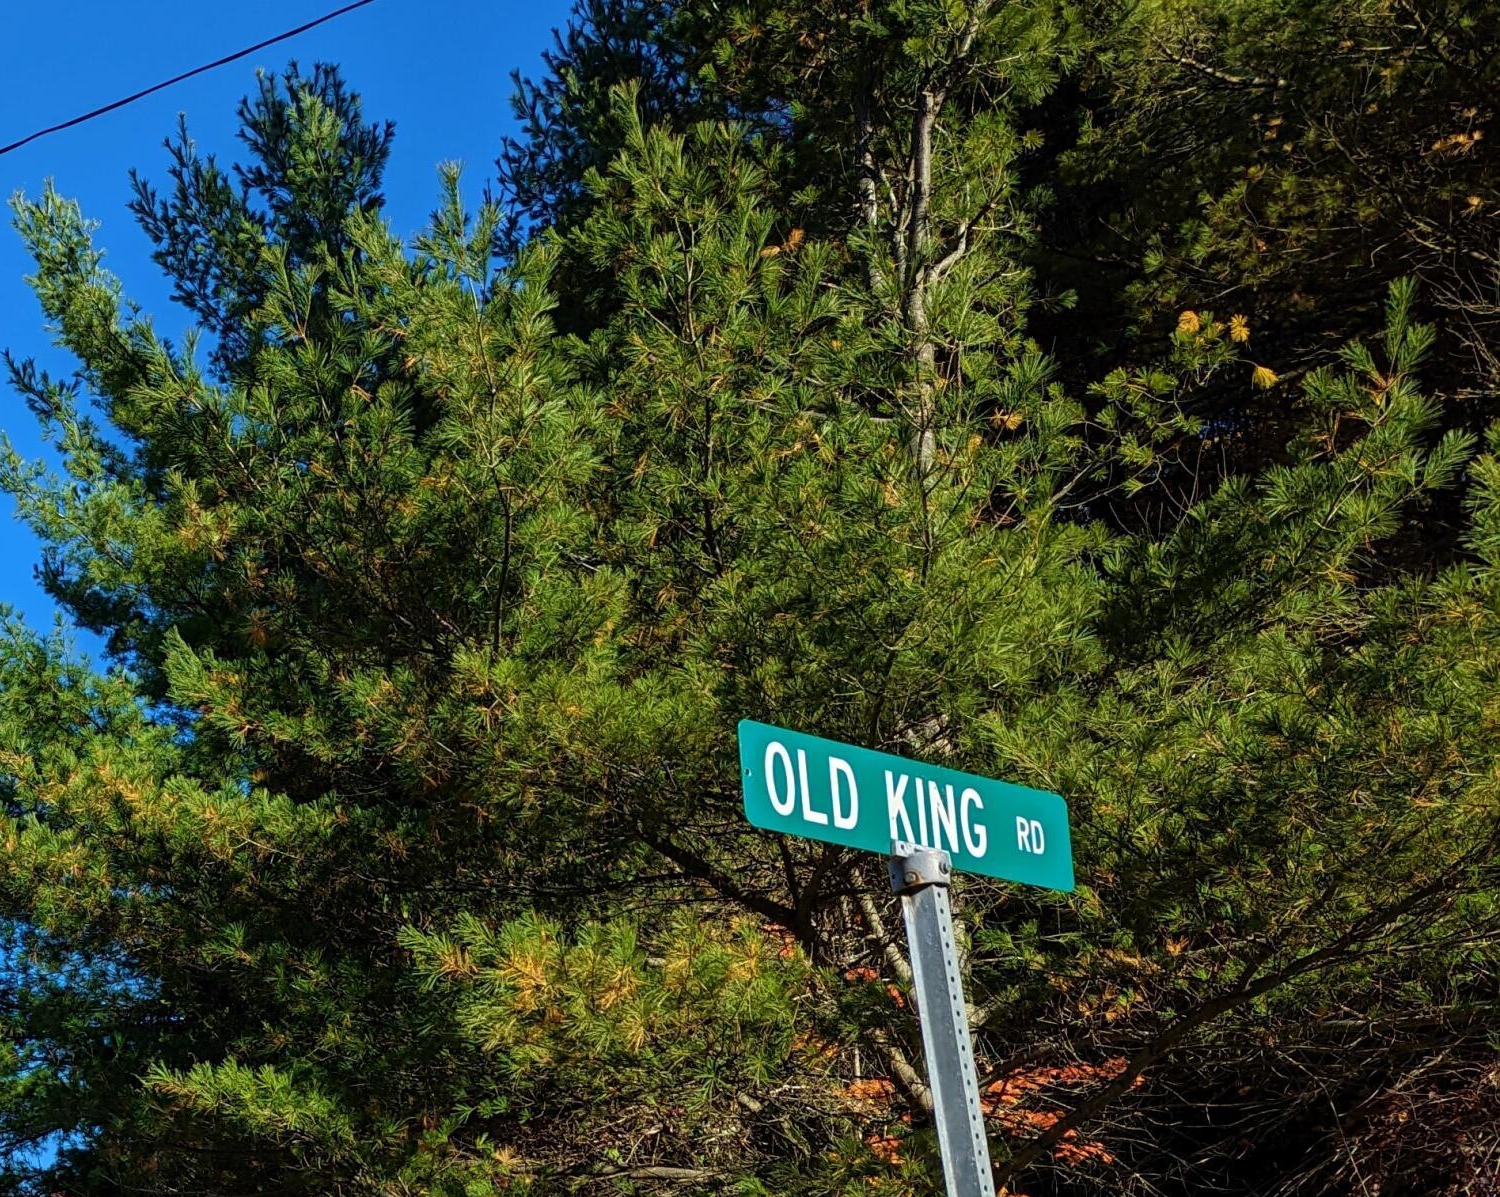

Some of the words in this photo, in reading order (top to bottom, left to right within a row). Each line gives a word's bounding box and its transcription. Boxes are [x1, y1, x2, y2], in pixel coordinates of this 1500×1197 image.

[764, 741, 858, 830] OLD
[885, 769, 988, 858] KING
[1015, 815, 1046, 855] RD
